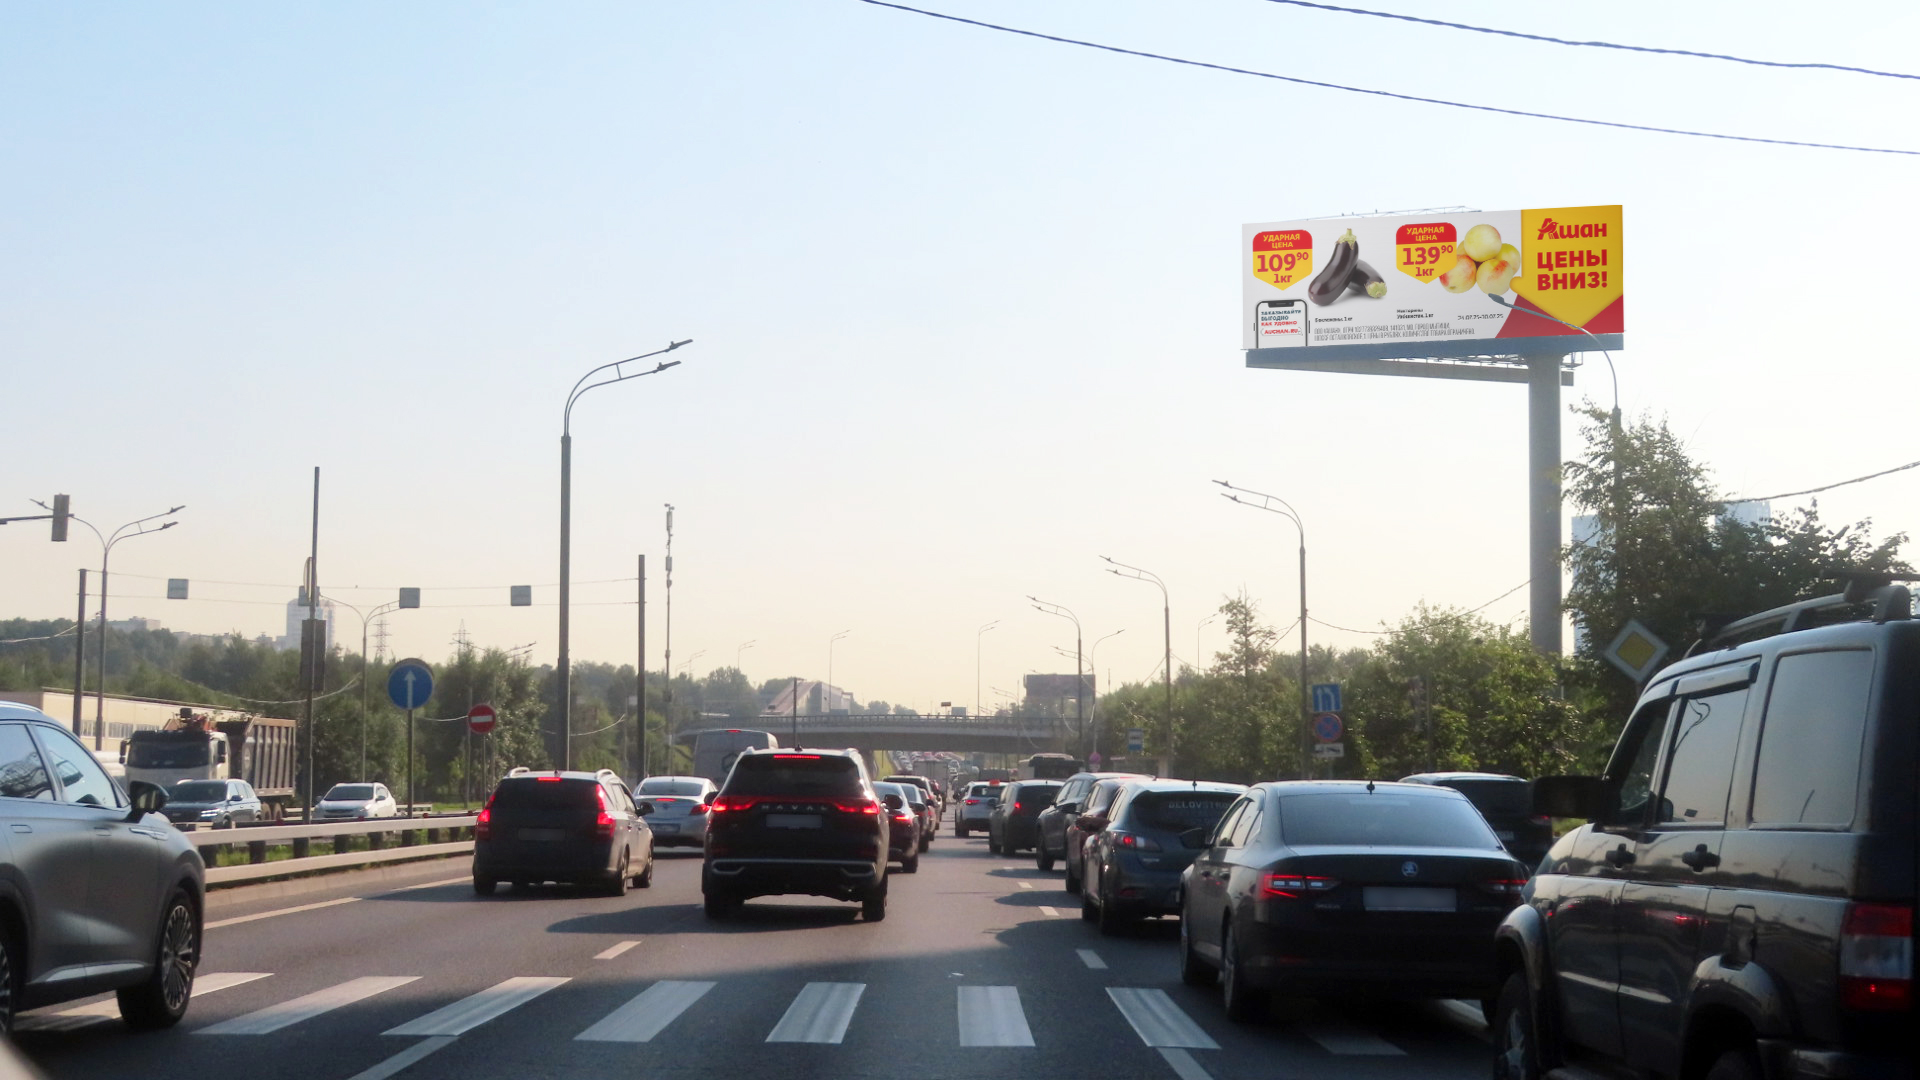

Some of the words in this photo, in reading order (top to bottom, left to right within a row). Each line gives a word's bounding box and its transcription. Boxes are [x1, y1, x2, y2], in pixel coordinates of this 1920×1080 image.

[1263, 233, 1300, 242] УДАРНАЯ
[1407, 226, 1444, 235] УДАРНАЯ
[1415, 234, 1437, 242] ЦЕНА
[1537, 217, 1607, 240] Ашан
[1271, 241, 1293, 249] ЦЕНА
[1257, 253, 1296, 273] 109
[1296, 252, 1309, 261] 90
[1403, 246, 1440, 266] 139
[1441, 245, 1454, 254] 90
[1537, 249, 1607, 271] ЦЕНЫ
[1537, 271, 1608, 291] ВНИЗ!
